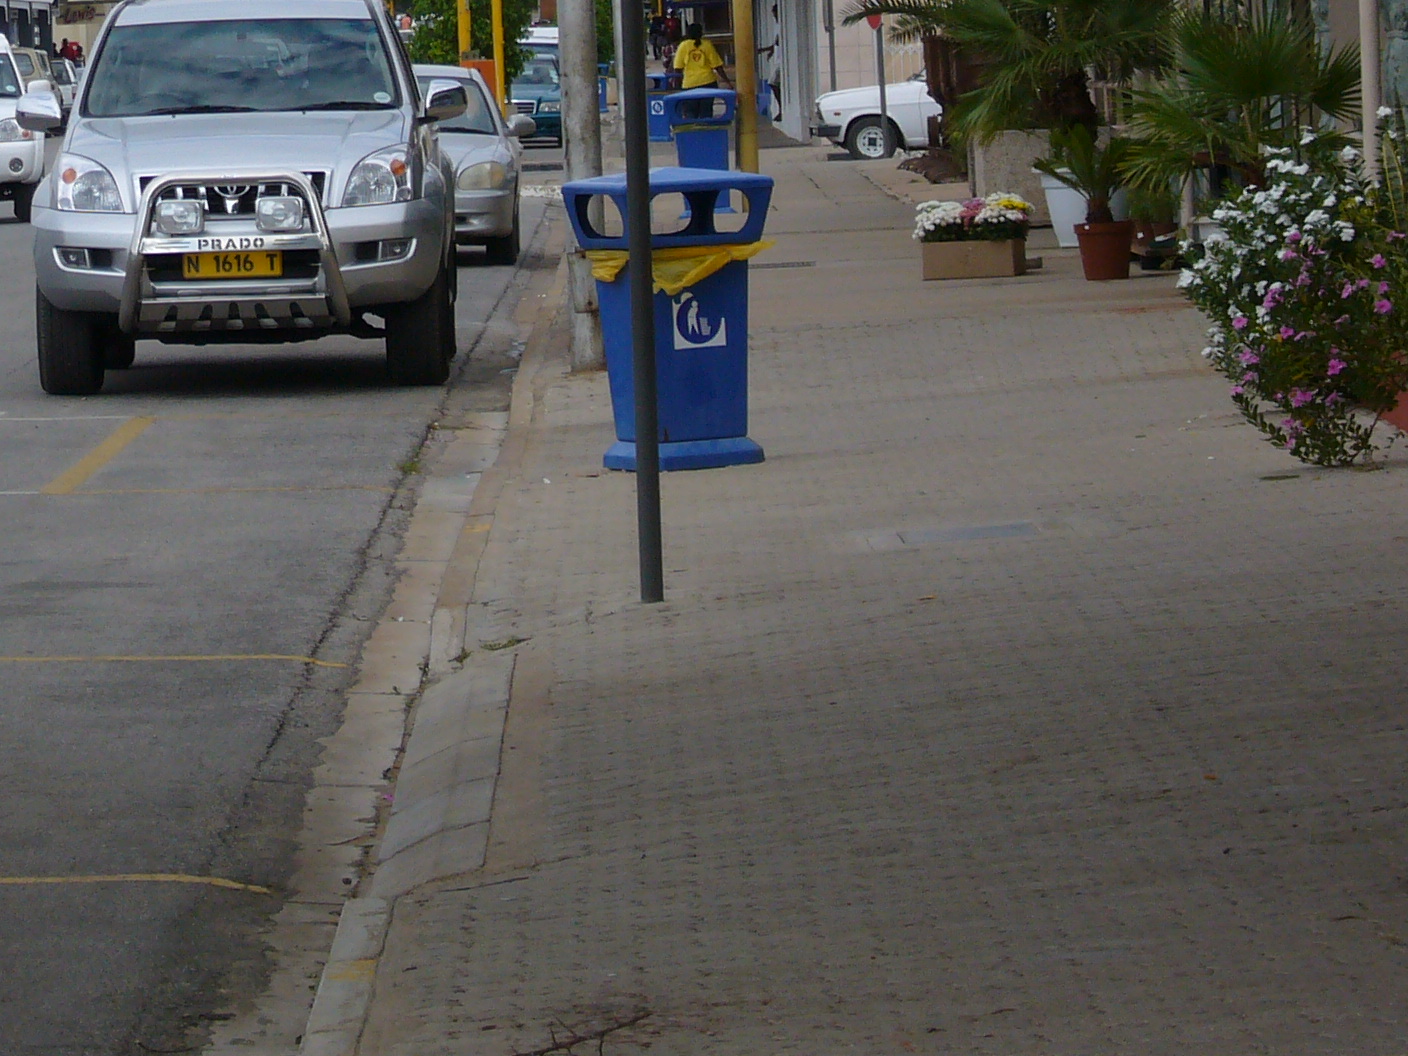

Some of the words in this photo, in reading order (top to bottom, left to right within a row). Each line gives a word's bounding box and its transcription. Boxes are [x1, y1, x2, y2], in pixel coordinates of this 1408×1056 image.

[197, 237, 265, 251] PRADO
[187, 255, 199, 274] N
[213, 254, 254, 273] 1616
[266, 253, 278, 271] T
